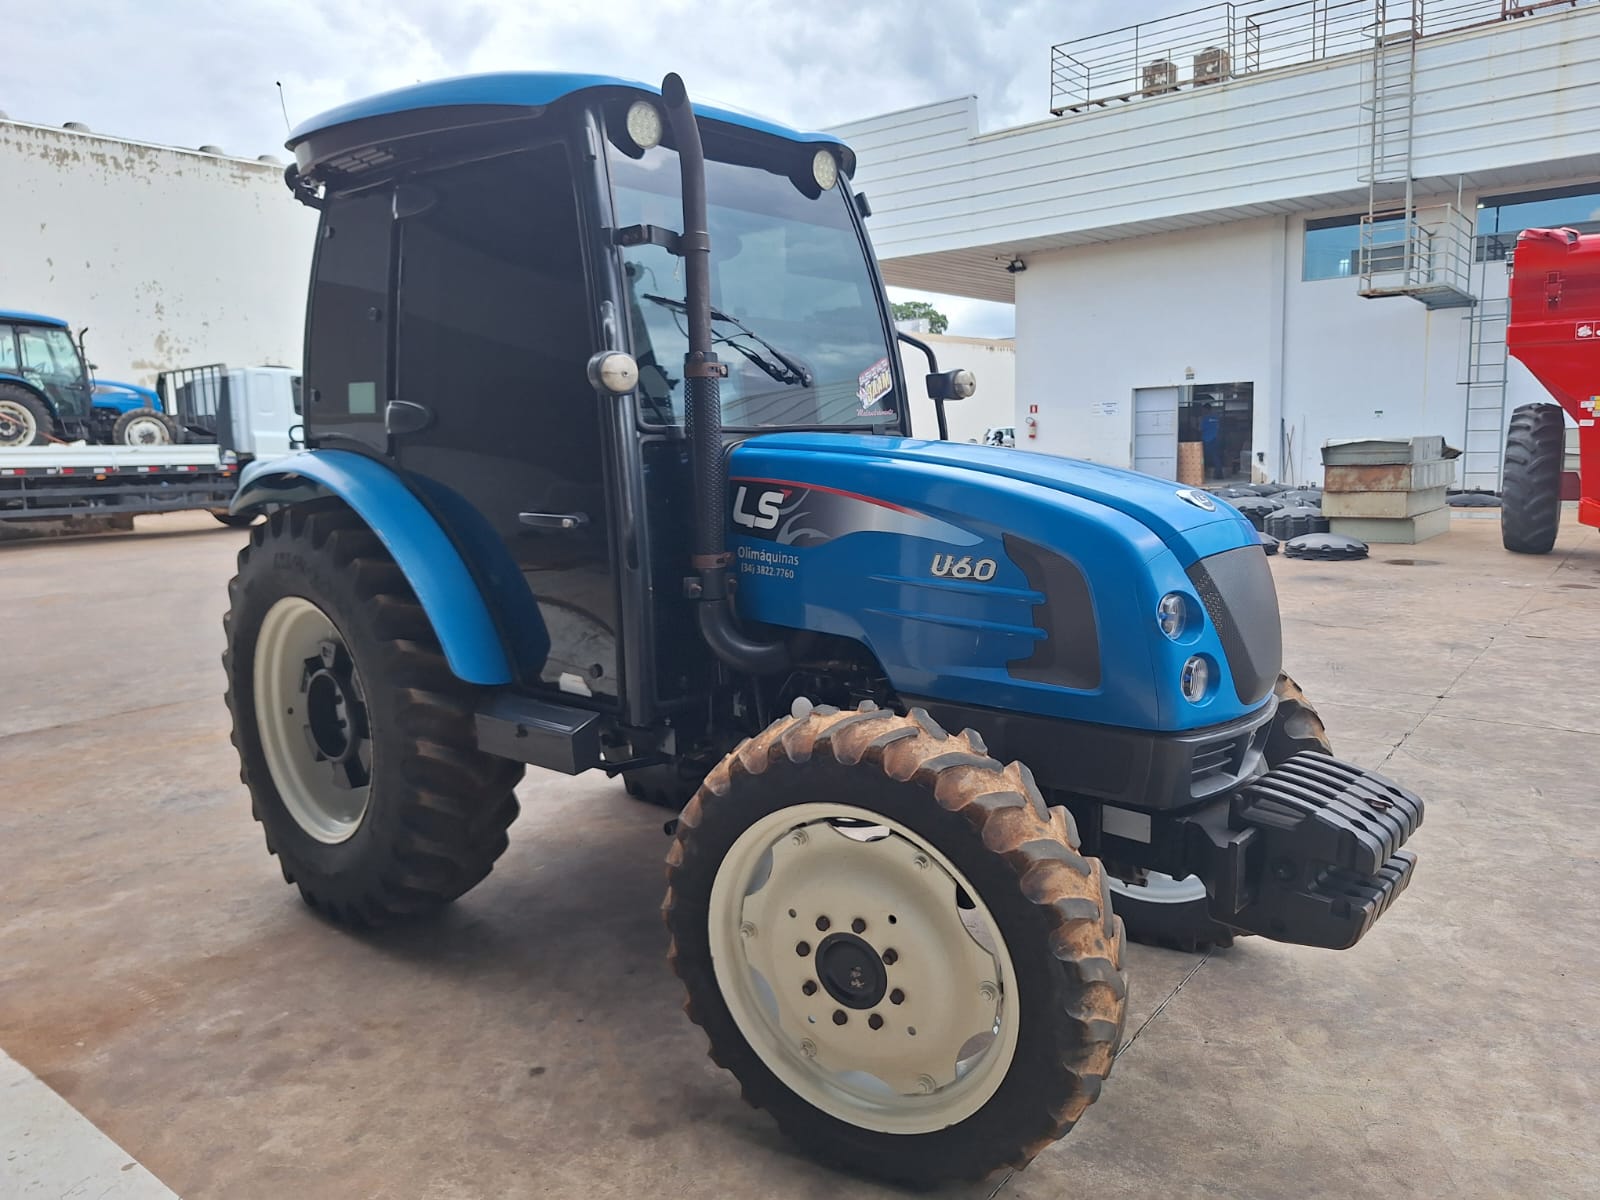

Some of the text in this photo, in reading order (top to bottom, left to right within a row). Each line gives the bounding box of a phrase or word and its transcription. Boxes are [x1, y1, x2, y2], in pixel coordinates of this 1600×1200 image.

[733, 486, 785, 530] LS
[737, 546, 799, 566] Olimáquinas
[931, 554, 997, 581] U60
[741, 562, 795, 579] (34) 3822.7760
